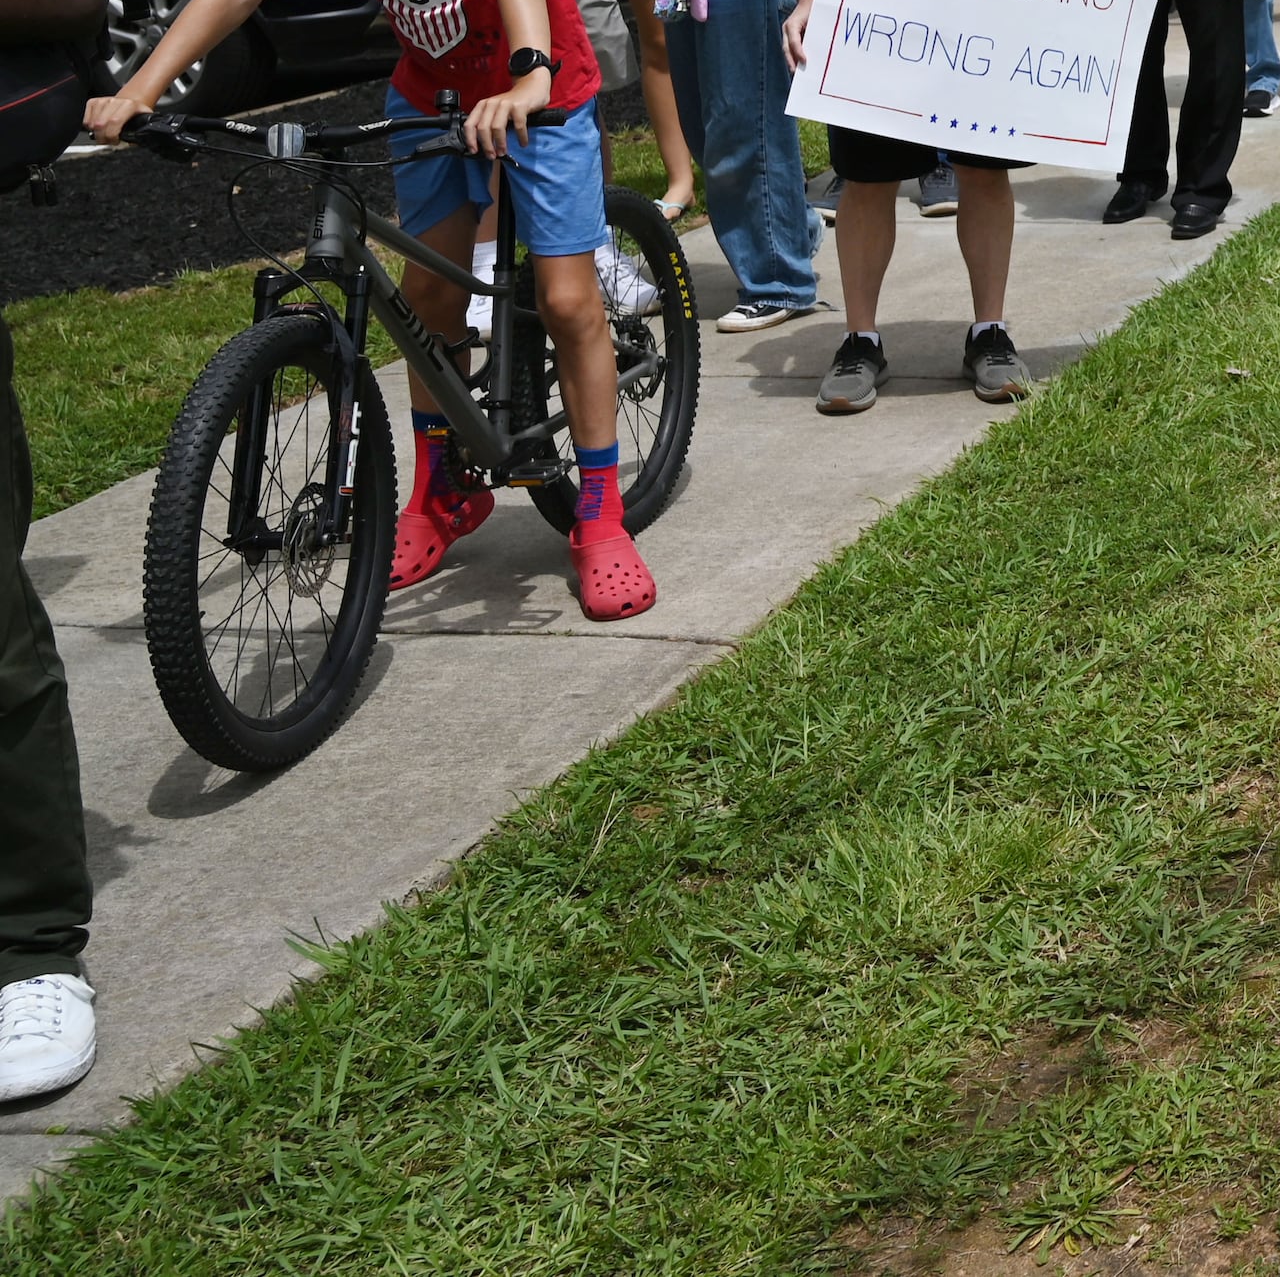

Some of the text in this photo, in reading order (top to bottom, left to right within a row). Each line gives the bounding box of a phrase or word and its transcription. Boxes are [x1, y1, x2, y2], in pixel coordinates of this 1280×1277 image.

[842, 9, 1115, 97] WRONG AGAIN
[669, 252, 692, 319] MAXXIS
